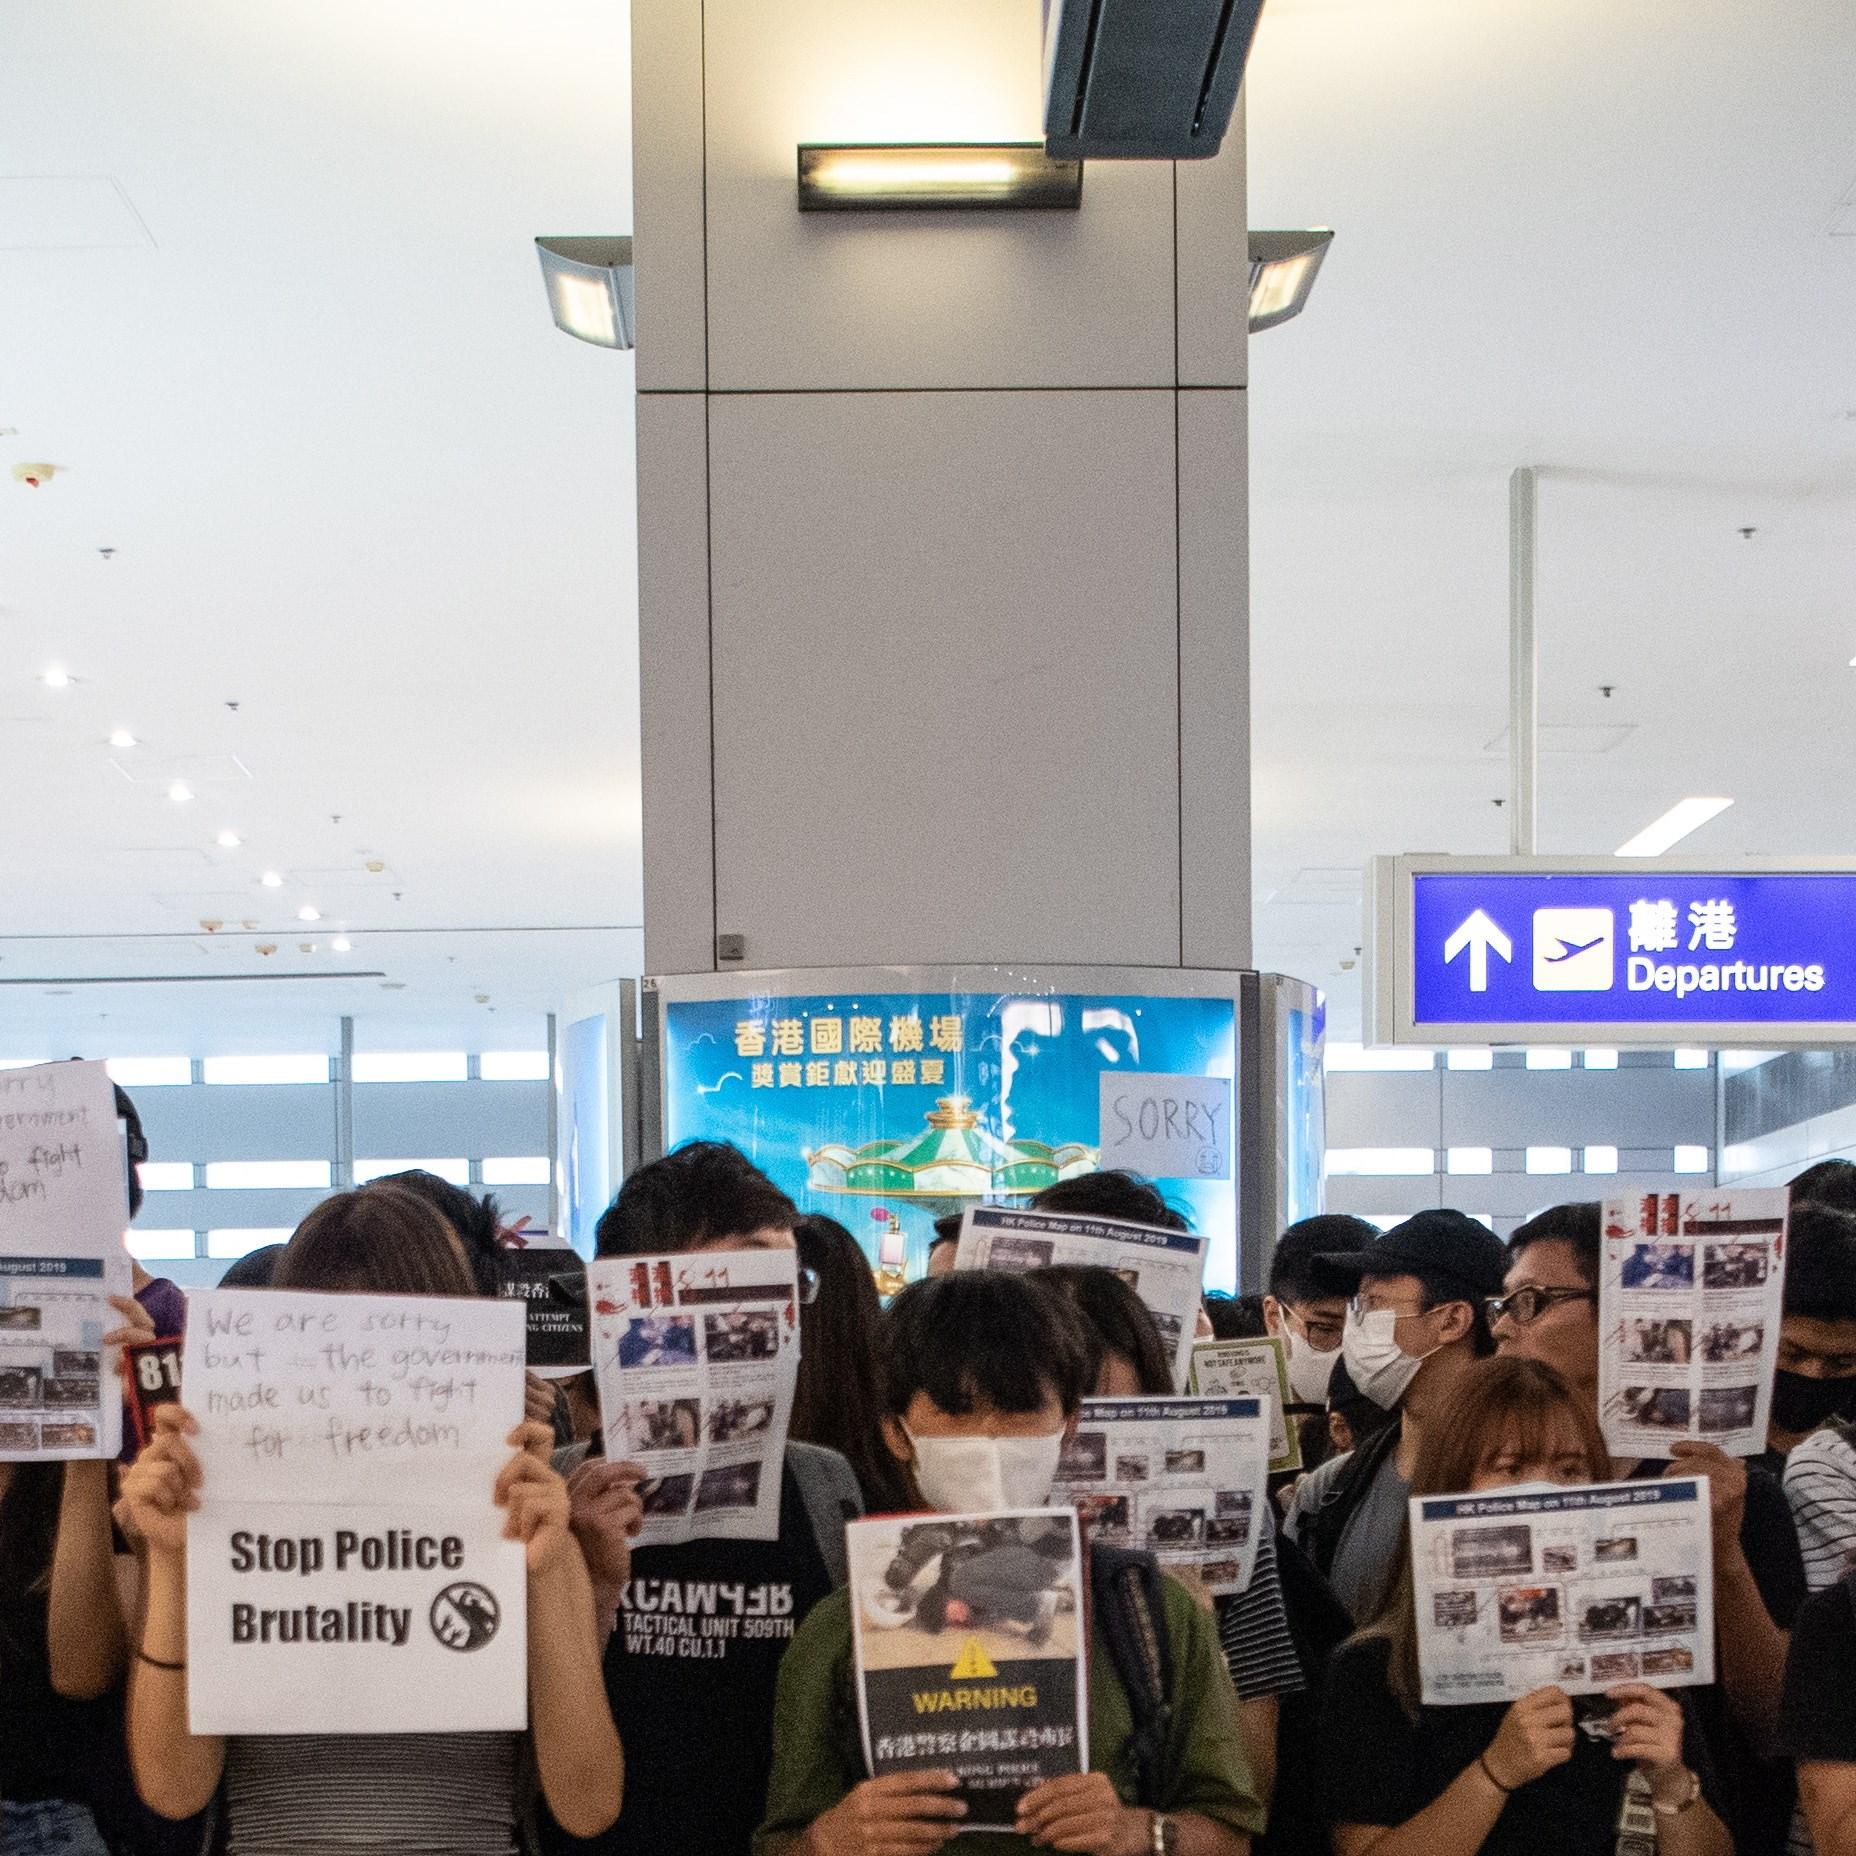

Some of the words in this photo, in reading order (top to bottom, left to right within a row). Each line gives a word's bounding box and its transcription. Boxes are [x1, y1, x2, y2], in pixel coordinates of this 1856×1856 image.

[1627, 898, 1736, 951] 離港
[1627, 957, 1825, 997] Departures
[733, 1015, 964, 1058] 香港國際機場
[750, 1059, 946, 1089] 獎賞鉅獻迎盛夏
[1112, 1095, 1222, 1146] SORRY
[28, 1143, 83, 1177] fight
[1018, 1219, 1046, 1231] Police
[1048, 1221, 1067, 1232] Map
[1070, 1224, 1082, 1233] on
[1107, 1227, 1142, 1243] August
[1144, 1233, 1168, 1245] 2019
[40, 1262, 66, 1273] 2019
[204, 1309, 254, 1338] We
[276, 1310, 341, 1333] are
[361, 1311, 451, 1343] sorry
[529, 1313, 570, 1321] ATTEMPT
[542, 1324, 583, 1332] CITIZENS
[202, 1344, 266, 1370] but
[321, 1343, 377, 1370] the
[208, 1383, 276, 1414] made
[298, 1384, 332, 1410] us
[360, 1379, 392, 1406] to
[410, 1376, 478, 1412] fight
[1163, 1405, 1200, 1419] August
[245, 1426, 285, 1459] for
[325, 1417, 460, 1458] freedom
[231, 1530, 324, 1576] Stop
[335, 1530, 465, 1571] Police
[232, 1601, 413, 1647] Brutality
[624, 1612, 696, 1637] TACTICAL
[700, 1617, 740, 1638] UNIT
[912, 1684, 1038, 1714] WARNING
